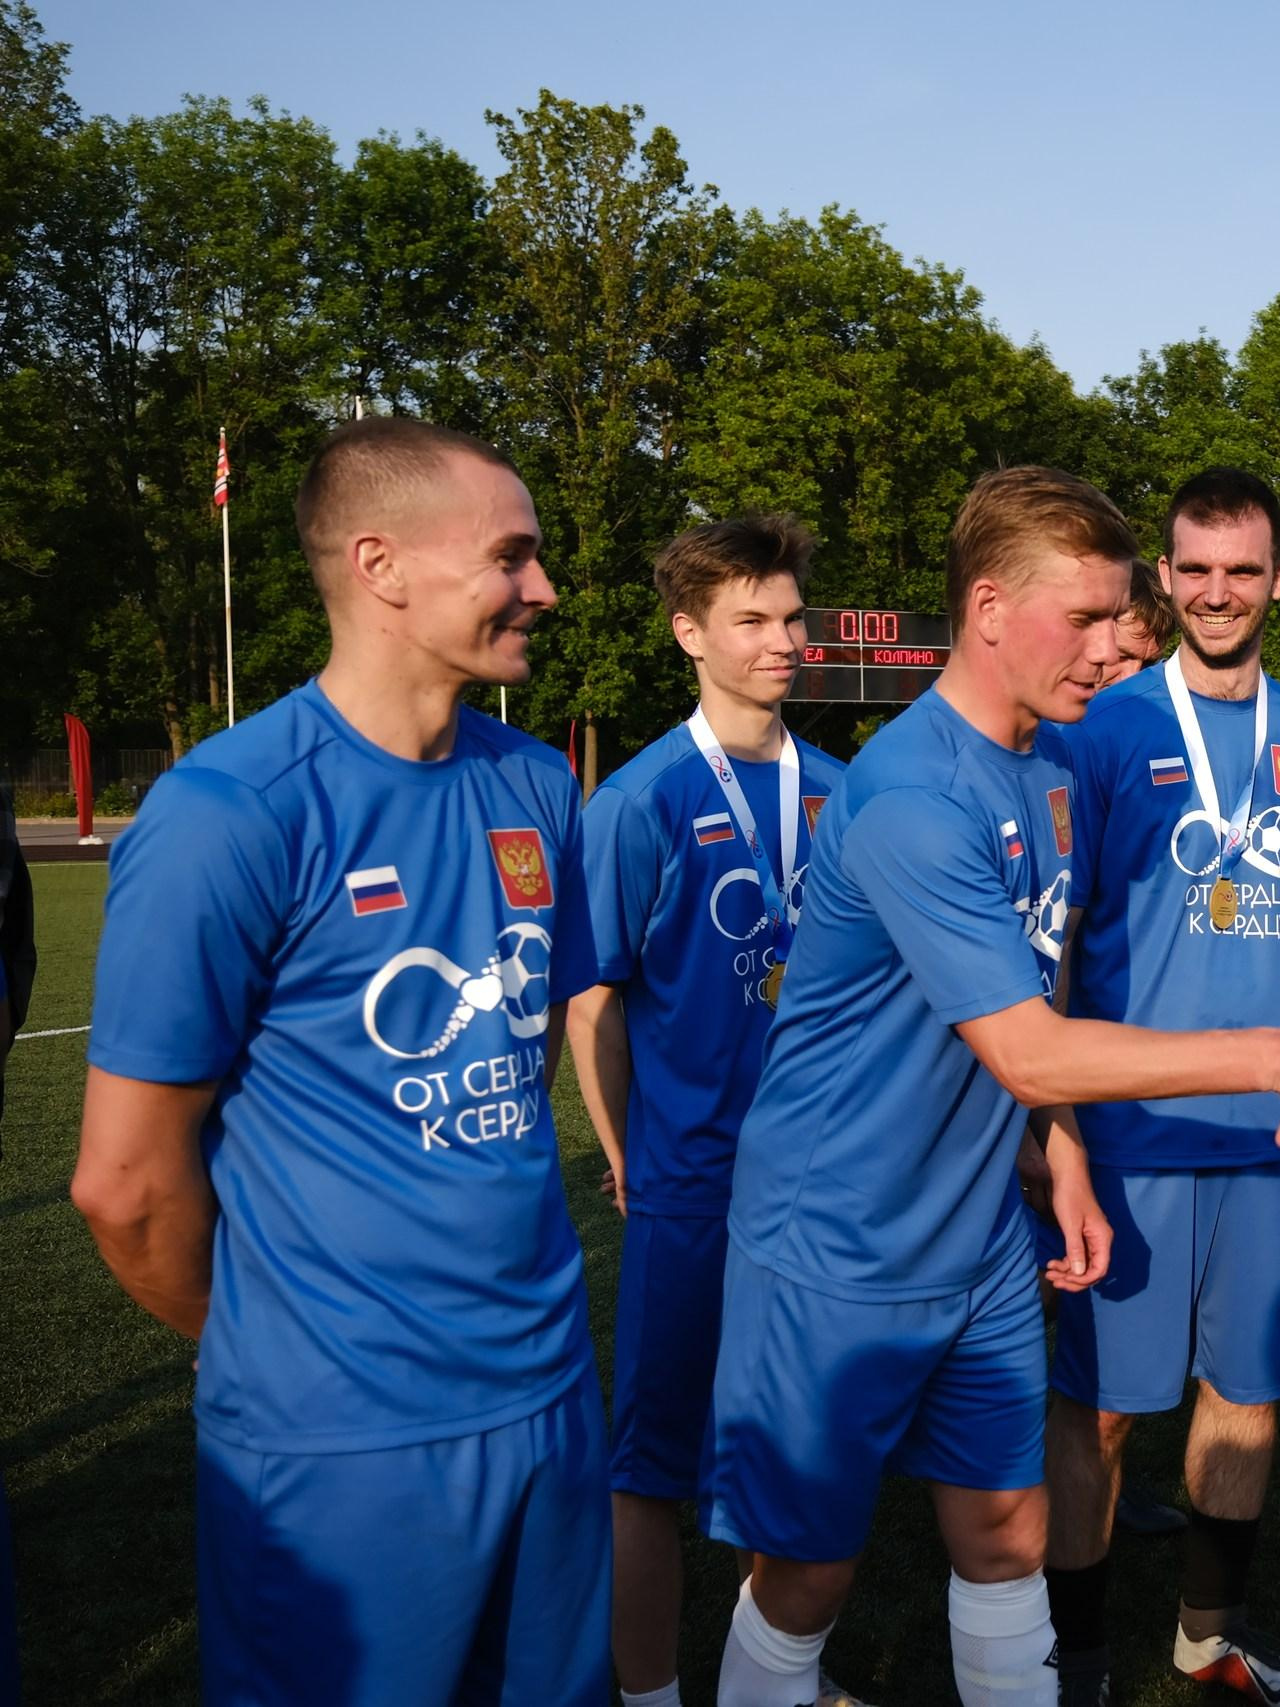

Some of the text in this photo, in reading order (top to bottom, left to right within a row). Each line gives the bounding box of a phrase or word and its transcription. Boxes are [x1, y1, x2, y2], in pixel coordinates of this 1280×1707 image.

[874, 650, 934, 664] КОЛПИНО
[1185, 884, 1212, 906] ОТ
[1189, 912, 1204, 934] К
[733, 949, 757, 976] ОТ
[744, 981, 754, 1006] К
[393, 1071, 450, 1113] ОТ
[420, 1115, 451, 1151] К
